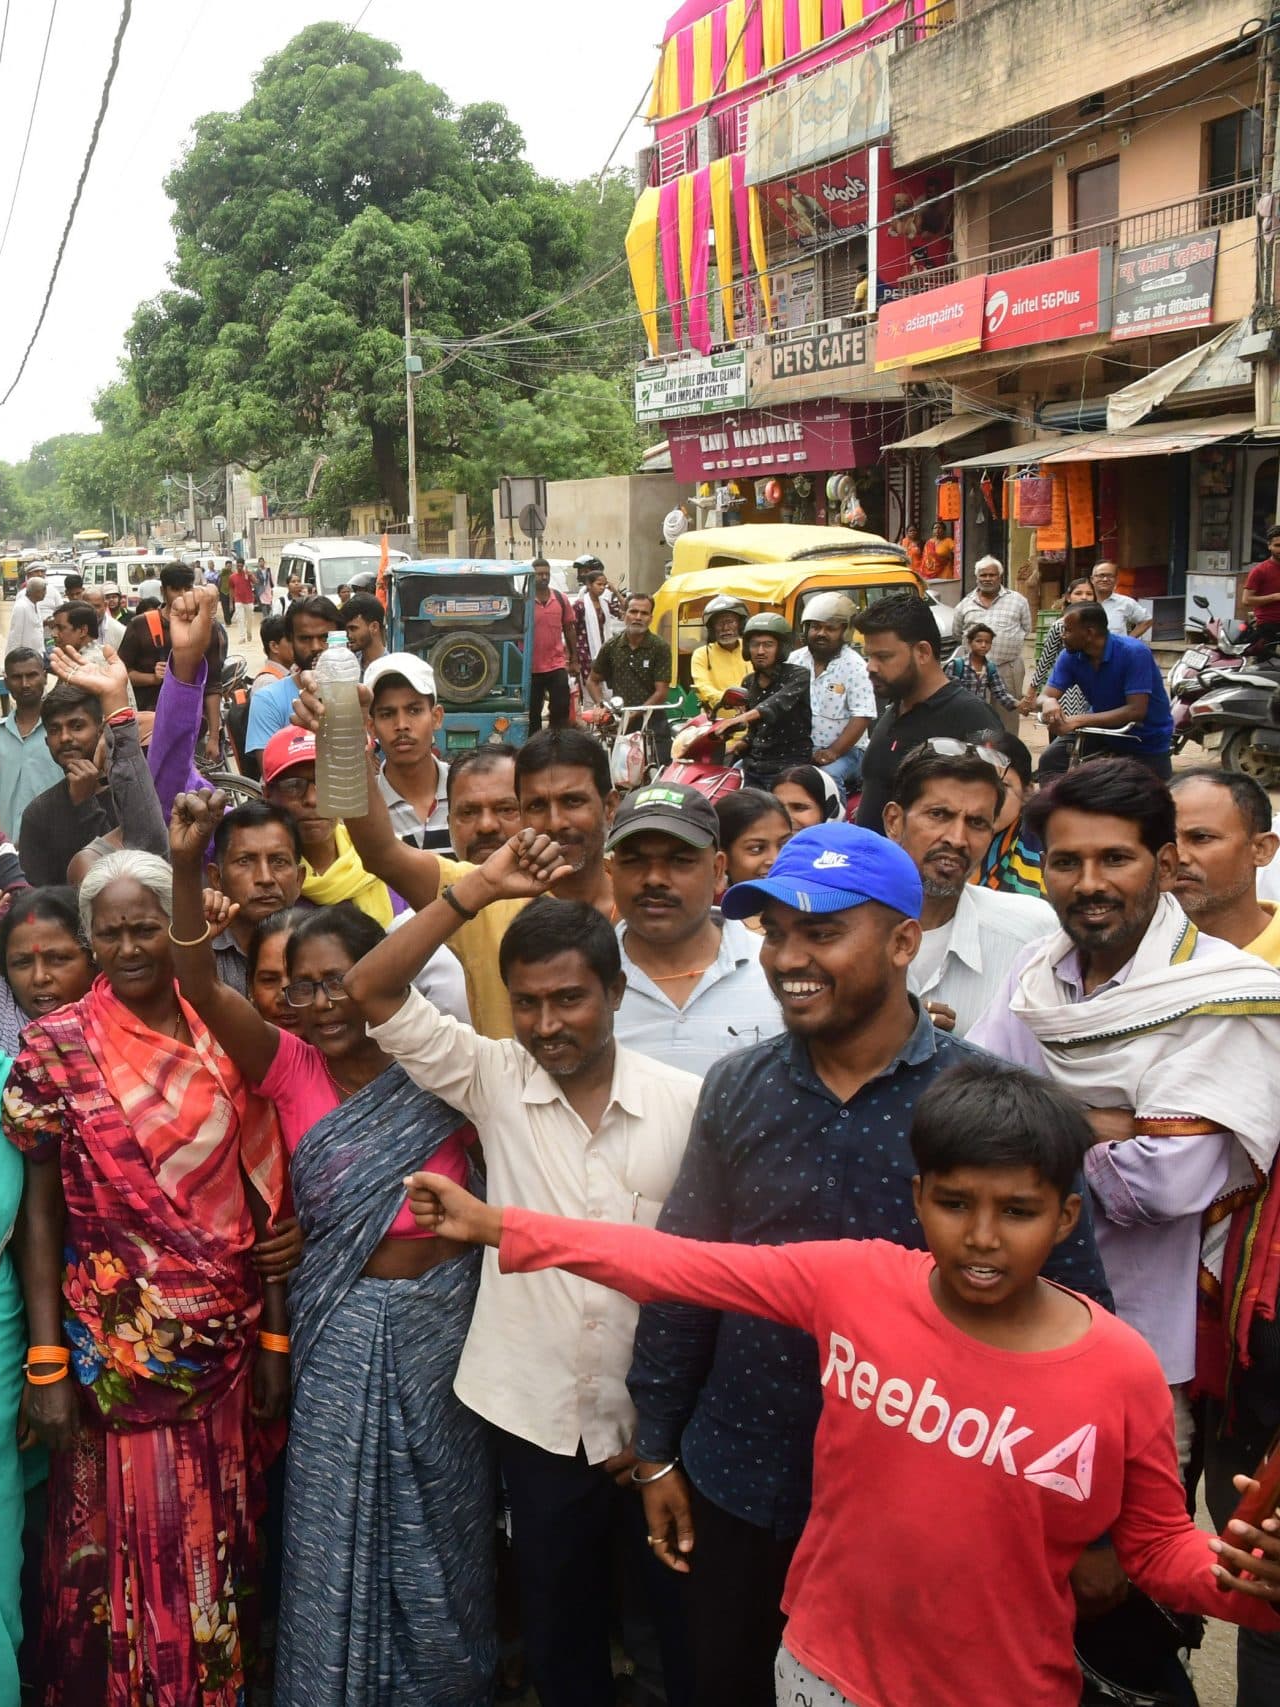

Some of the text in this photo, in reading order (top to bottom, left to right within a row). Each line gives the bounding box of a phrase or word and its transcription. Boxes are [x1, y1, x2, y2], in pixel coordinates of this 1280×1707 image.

[822, 176, 866, 201] drools
[905, 303, 965, 334] asianpaints
[1012, 296, 1039, 316] airtel
[773, 331, 864, 376] PETS CAFE
[653, 379, 677, 393] HEALTHY
[678, 374, 696, 388] SMILE
[696, 370, 718, 386] DENTAL
[719, 366, 741, 381] CLINIC
[665, 383, 728, 405] AND IMPLANT CENTRE
[732, 422, 804, 449] HARDWARE
[819, 850, 849, 866] NIKE
[820, 1331, 1035, 1477] Reebok
